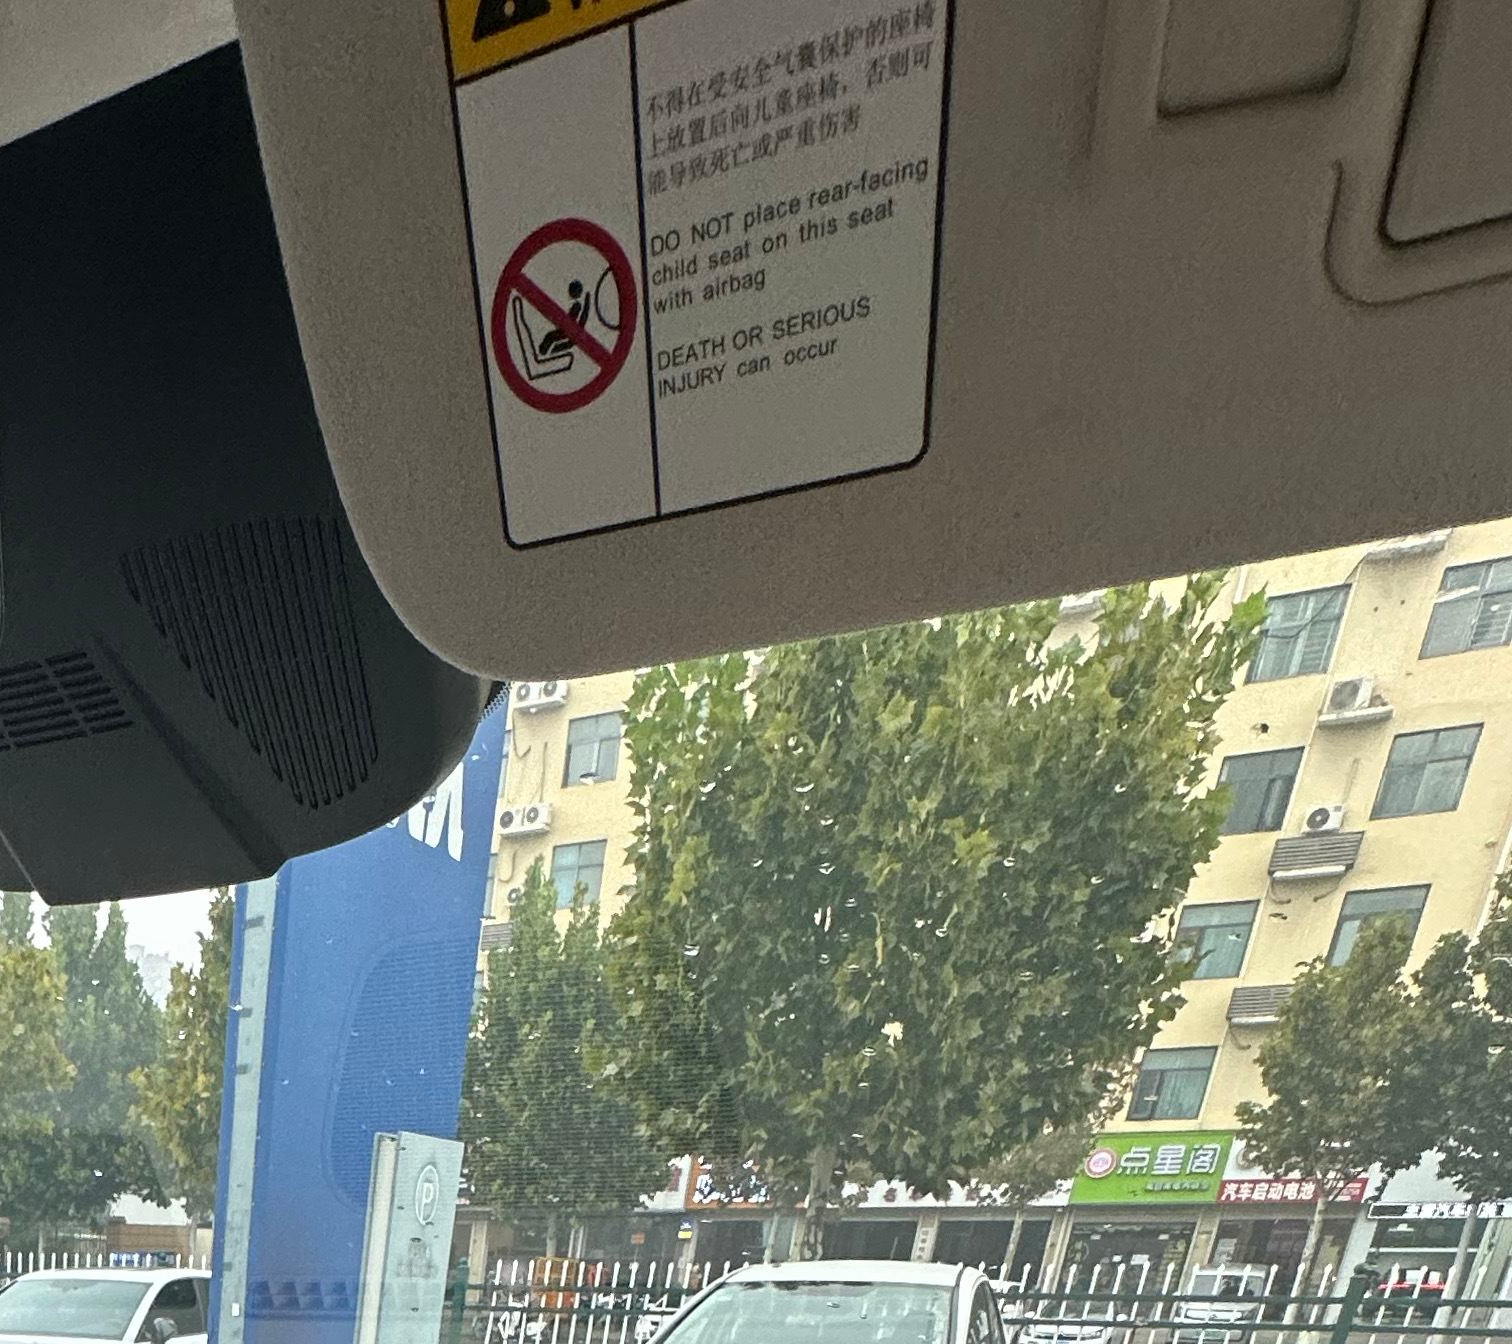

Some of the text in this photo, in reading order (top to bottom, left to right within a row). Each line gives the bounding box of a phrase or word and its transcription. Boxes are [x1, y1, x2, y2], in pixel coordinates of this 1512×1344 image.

[651, 157, 928, 257] DO NOT place rear-facing
[652, 199, 894, 286] child seat on this seat
[654, 268, 766, 315] with airbag
[657, 296, 871, 371] DEATH OR SERIOUS
[658, 338, 838, 399] INJURY can occur
[1116, 1142, 1222, 1177] 点星阁
[1221, 1181, 1318, 1202] 汽车启动电池
